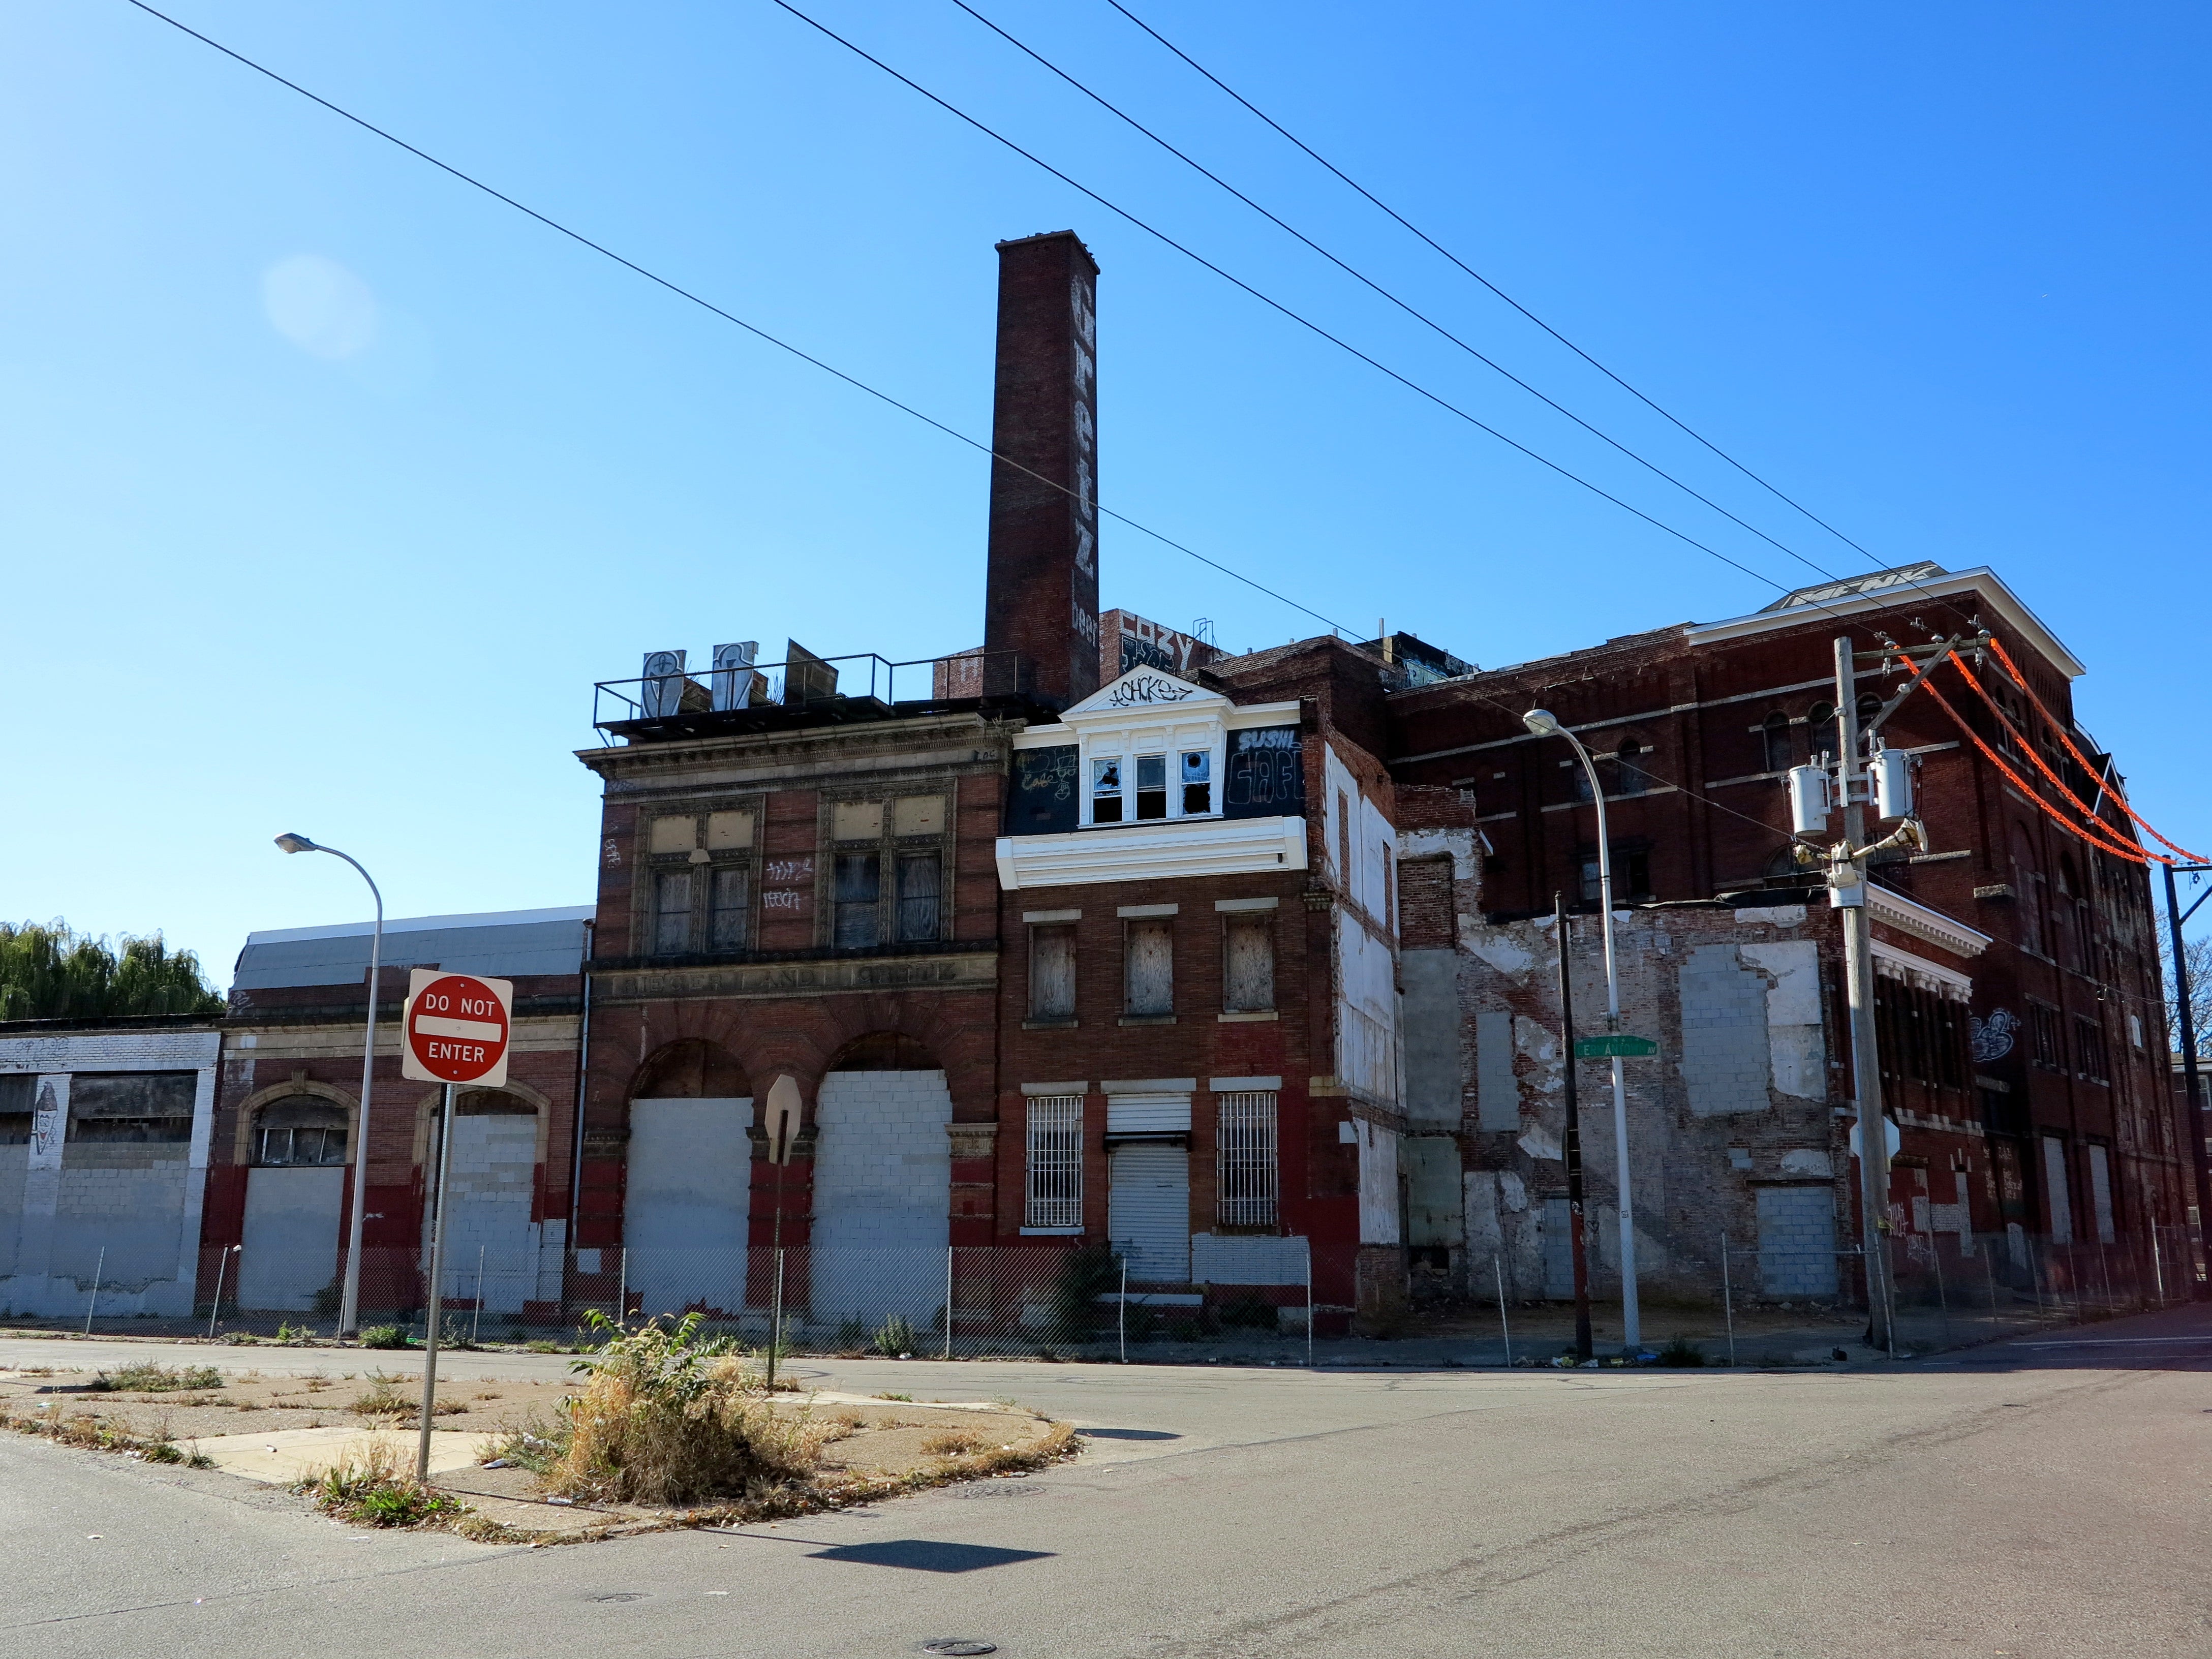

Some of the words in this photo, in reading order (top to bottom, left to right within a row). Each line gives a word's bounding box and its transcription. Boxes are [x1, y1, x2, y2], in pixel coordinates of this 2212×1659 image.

[1119, 611, 1194, 671] COZY
[759, 968, 815, 989] AND
[425, 994, 449, 1011] DO
[460, 998, 495, 1016] NOT
[428, 1042, 484, 1063] ENTER
[1647, 1046, 1656, 1055] AV
